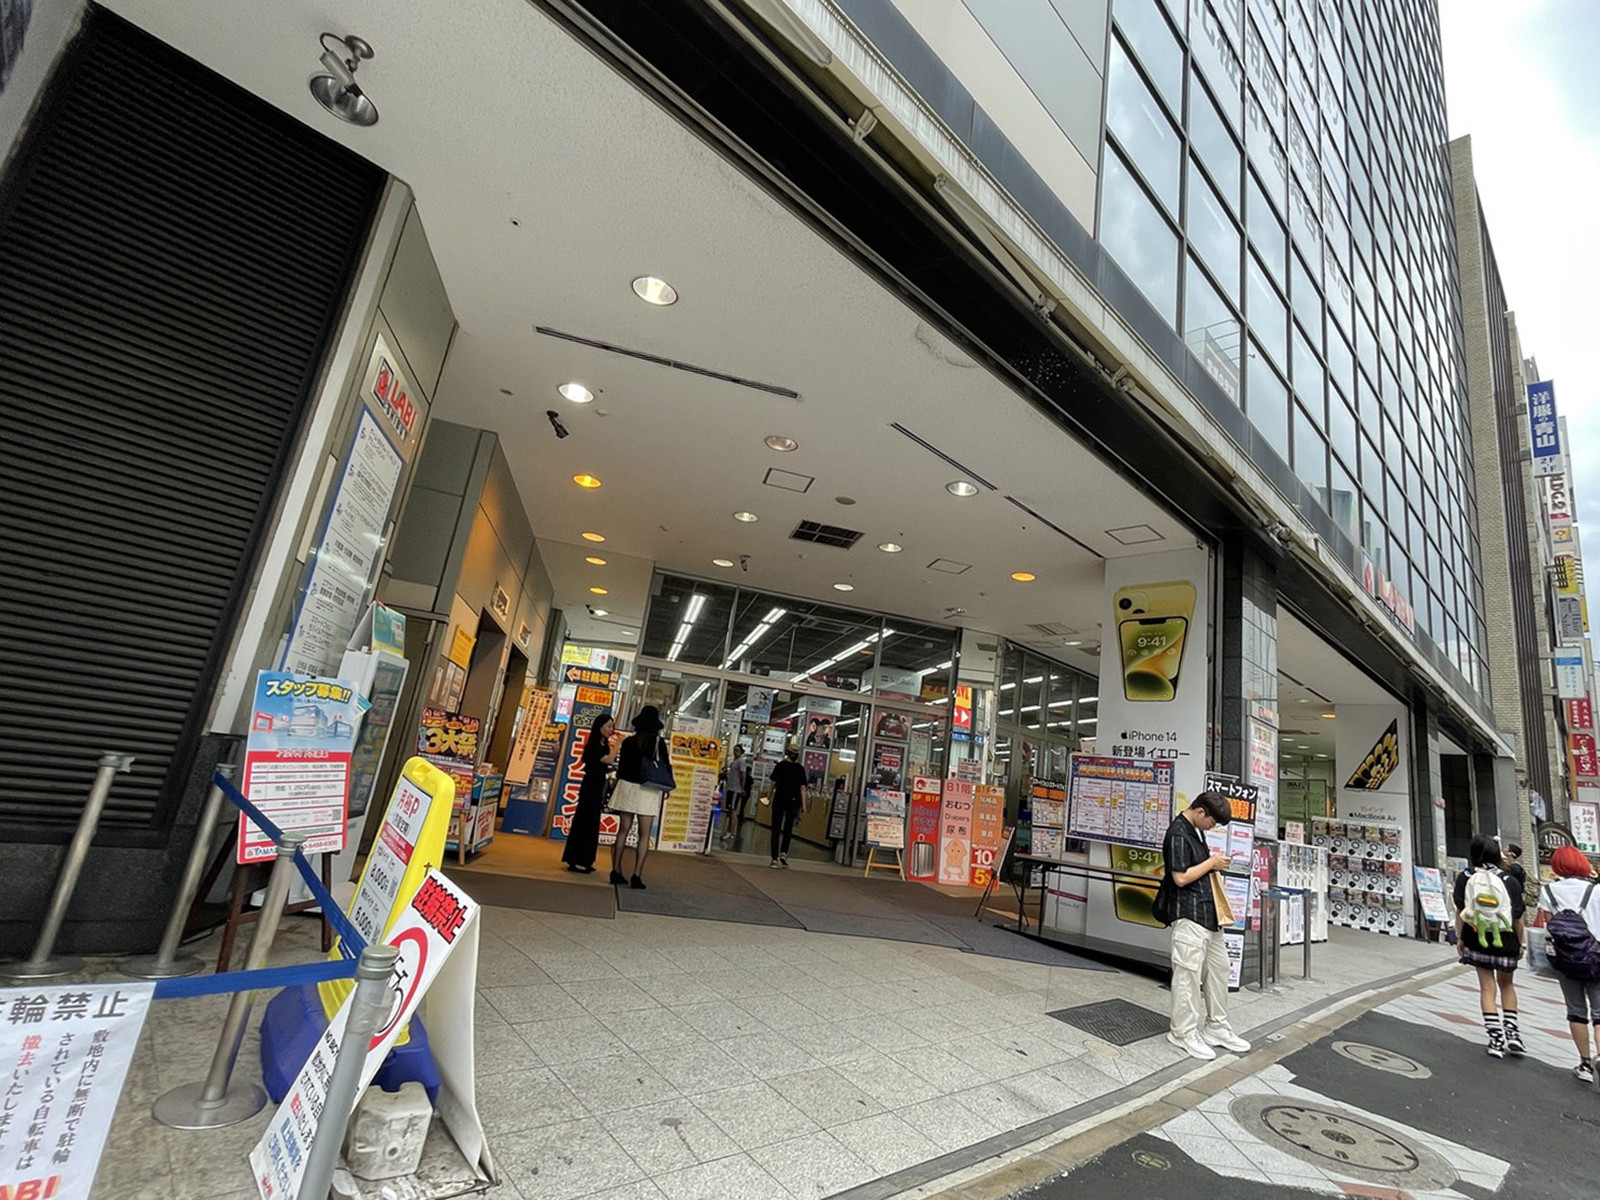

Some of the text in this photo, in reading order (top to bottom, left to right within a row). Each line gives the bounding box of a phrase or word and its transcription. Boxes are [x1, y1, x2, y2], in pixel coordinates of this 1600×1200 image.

[390, 379, 418, 434] LABI
[1531, 390, 1556, 448] 洋服の青山
[1137, 636, 1167, 648] 9:41
[266, 679, 352, 704] スタッフ募集!!
[1129, 731, 1177, 742] iPhone 14
[1207, 782, 1257, 800] スマートフォン
[945, 800, 971, 811] おむつ
[1353, 811, 1385, 821] MacBook
[1128, 849, 1161, 863] 9:41
[411, 874, 468, 945] 駐輪禁止
[0, 990, 130, 1025] 輪禁止
[15, 1032, 75, 1171] されている自転車は
[52, 1029, 110, 1165] 敷地内に無断で駐輪
